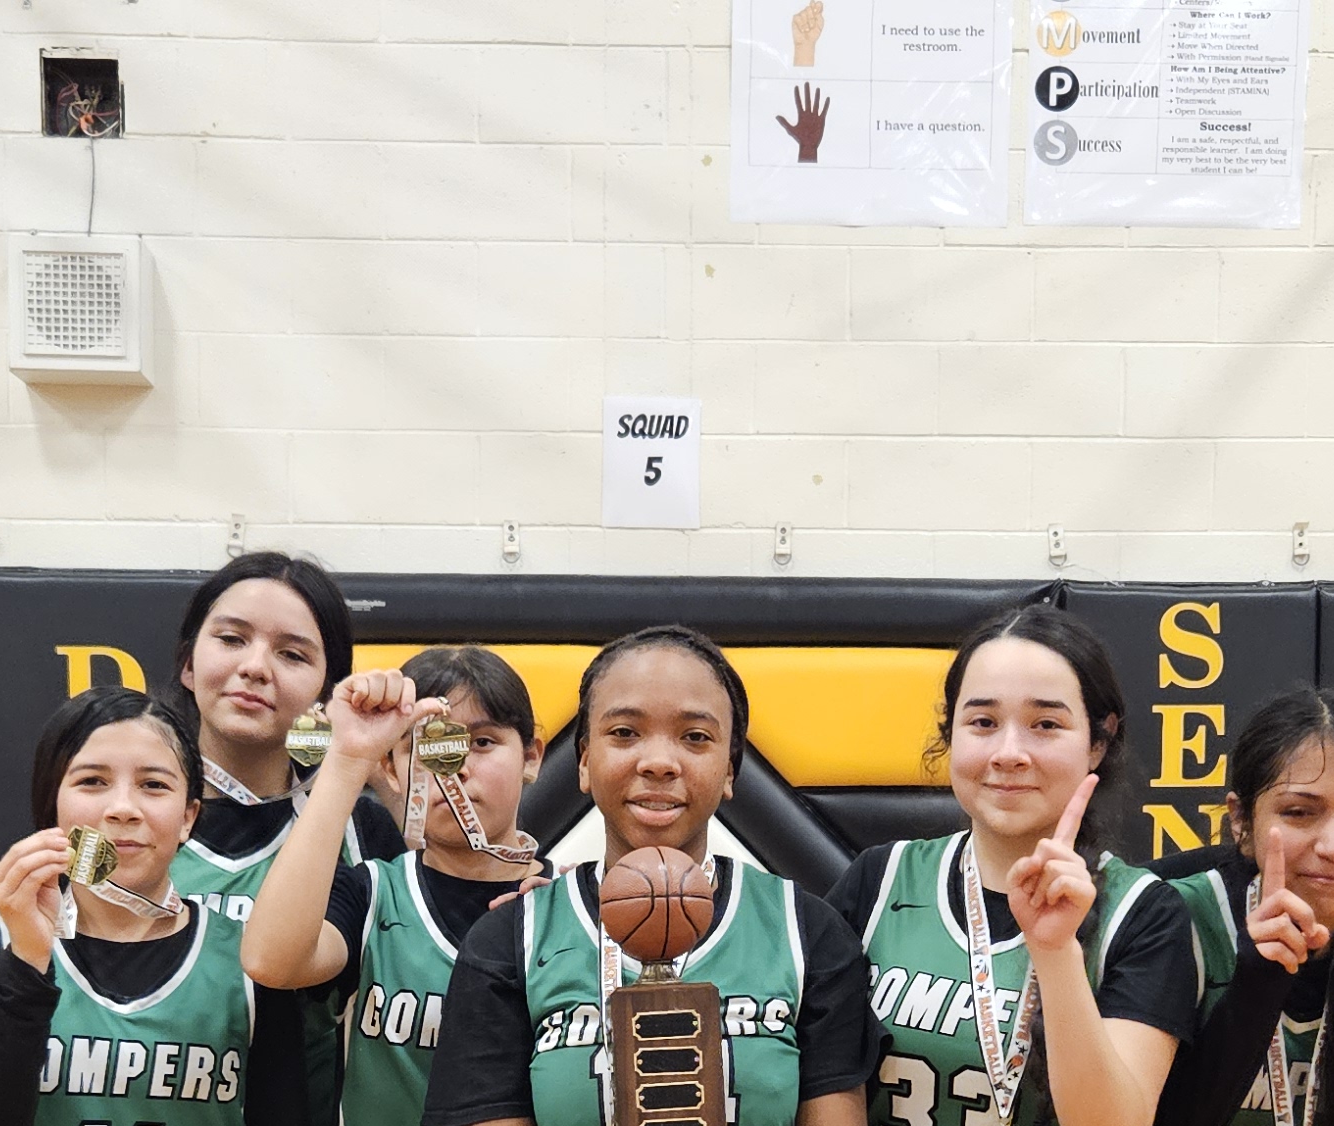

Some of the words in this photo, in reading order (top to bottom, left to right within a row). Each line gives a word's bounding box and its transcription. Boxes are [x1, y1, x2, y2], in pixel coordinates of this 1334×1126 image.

[881, 25, 886, 35] I
[890, 25, 919, 36] need
[923, 26, 935, 36] to
[939, 28, 961, 37] use
[965, 26, 985, 37] the
[1178, 22, 1195, 30] Stay
[1041, 18, 1141, 50] Movement
[903, 42, 962, 52] restroom.
[1177, 42, 1198, 50] Move
[1226, 43, 1258, 51] Directed
[1170, 65, 1189, 73] How
[1214, 66, 1238, 75] Being
[1240, 67, 1286, 75] Attentive?
[1049, 71, 1160, 106] Participation
[1175, 86, 1225, 95] Independent
[1174, 108, 1196, 116] Open
[876, 120, 881, 131] I
[884, 121, 914, 132] have
[917, 123, 924, 131] a
[929, 121, 985, 134] question.
[1199, 121, 1252, 131] Success!
[1045, 125, 1122, 160] Success
[617, 413, 689, 439] SQUAD
[644, 456, 663, 486] 5
[419, 740, 469, 756] BASKETBALL
[75, 832, 99, 885] BASKETBALL
[38, 1034, 241, 1102] OMPERS
